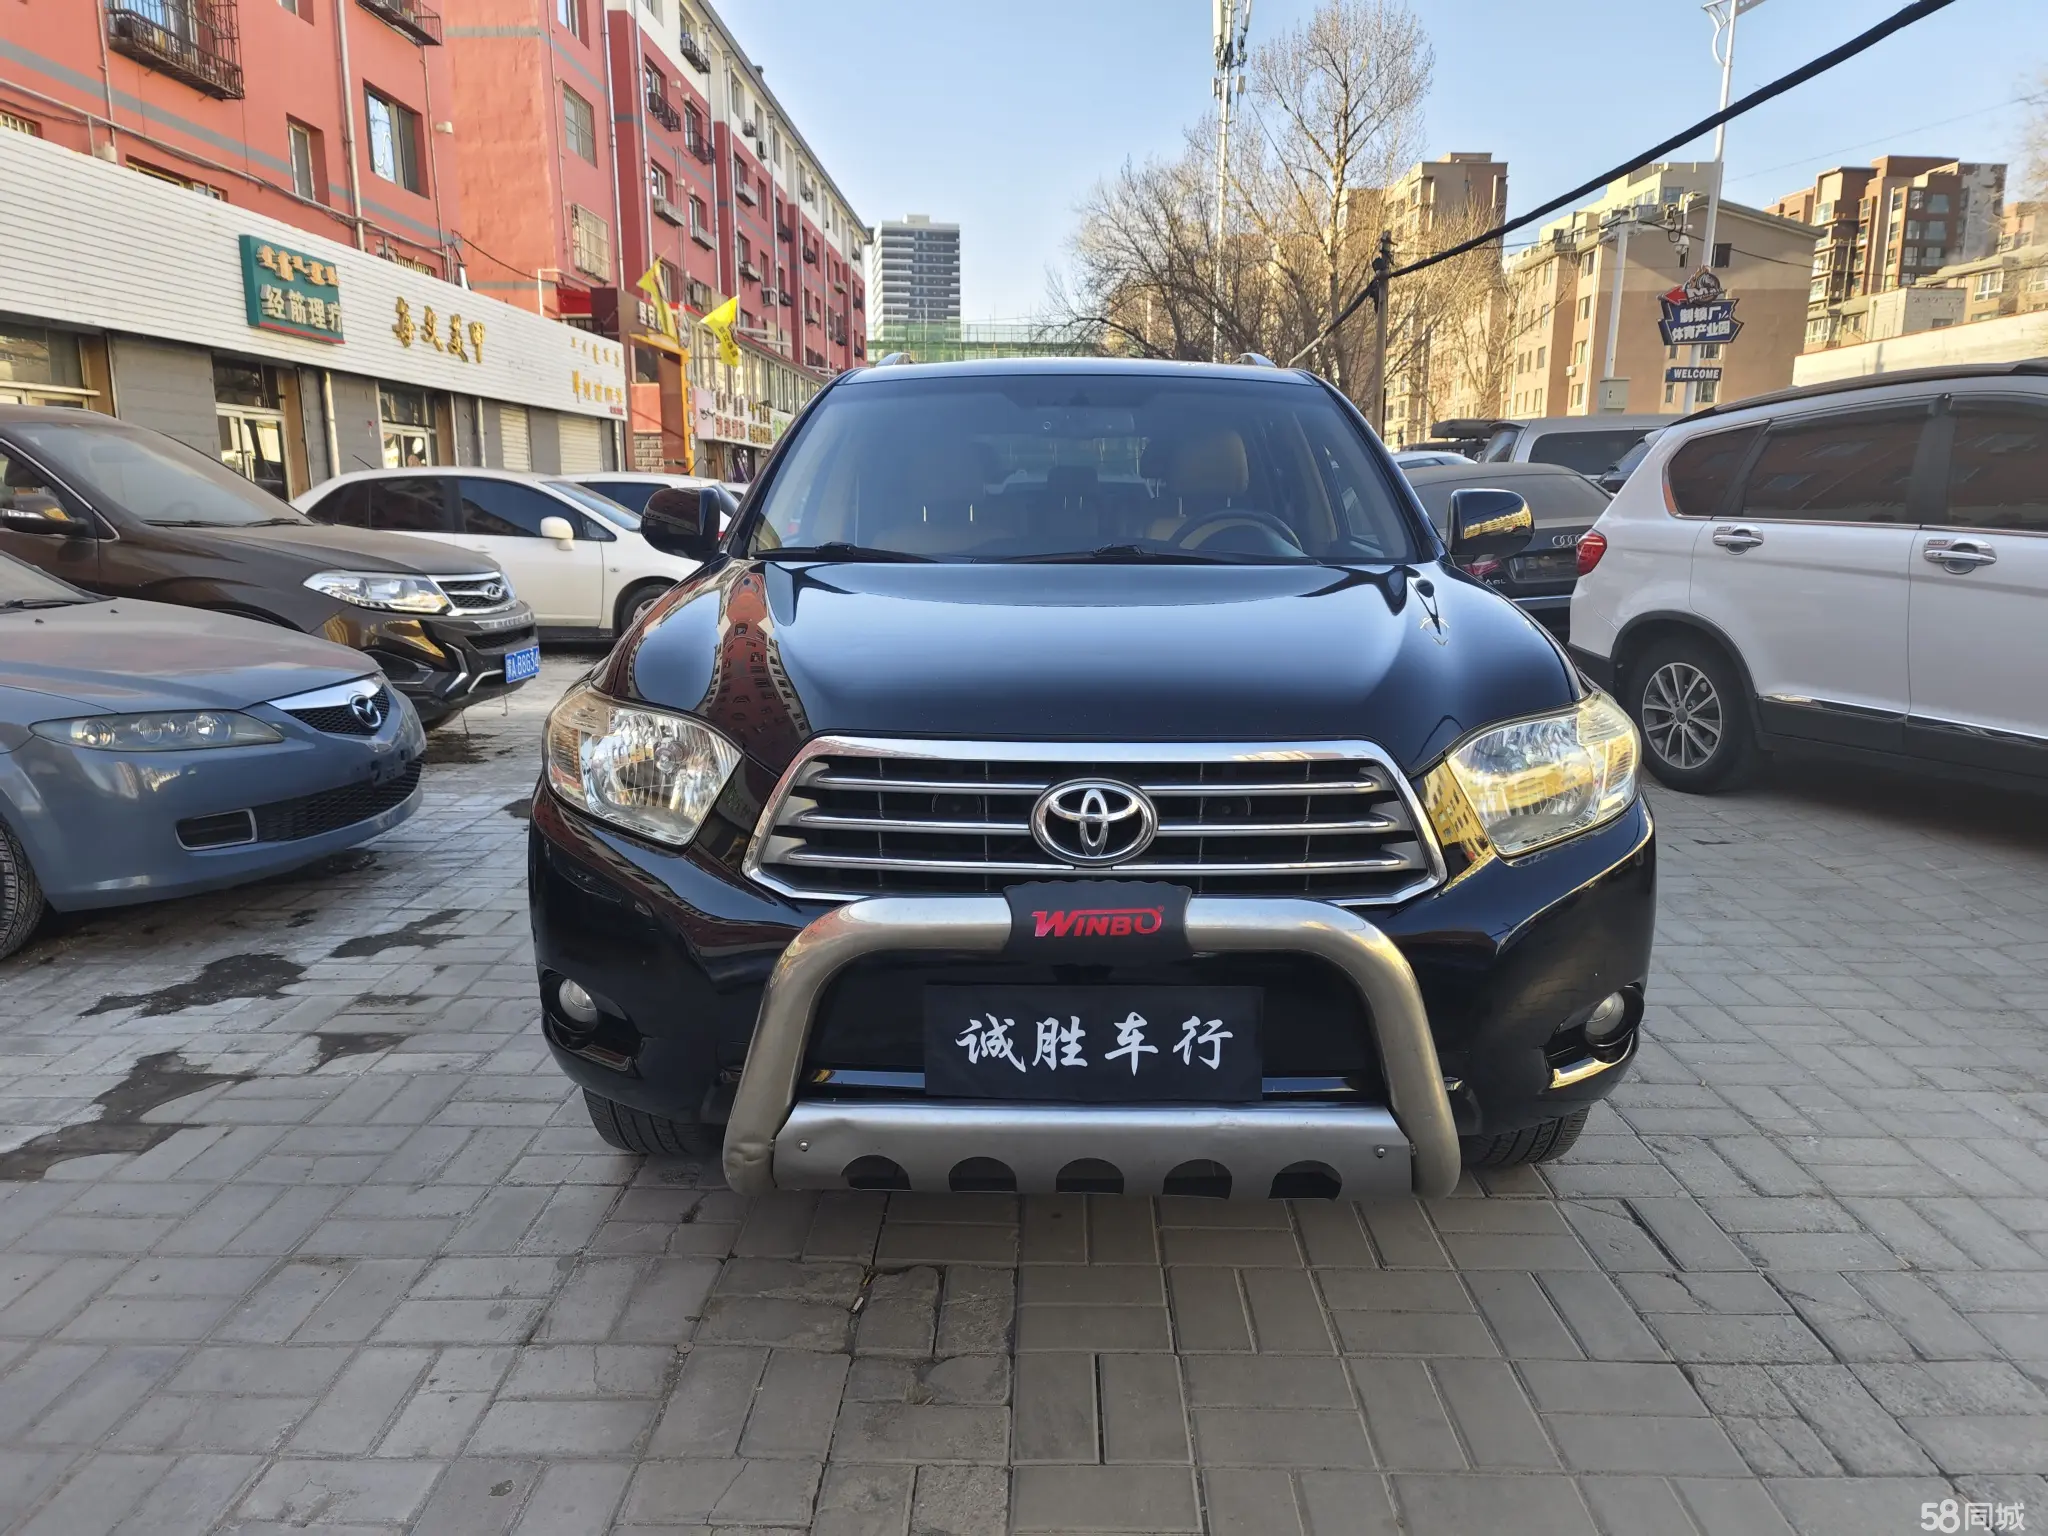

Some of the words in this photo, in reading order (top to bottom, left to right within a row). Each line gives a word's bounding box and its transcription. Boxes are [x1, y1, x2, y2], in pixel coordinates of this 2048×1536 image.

[1672, 321, 1730, 340] 体育产业园
[1673, 368, 1719, 379] WELCOME
[1031, 907, 1163, 938] WINBO
[955, 1012, 1234, 1077] 诚胜车行
